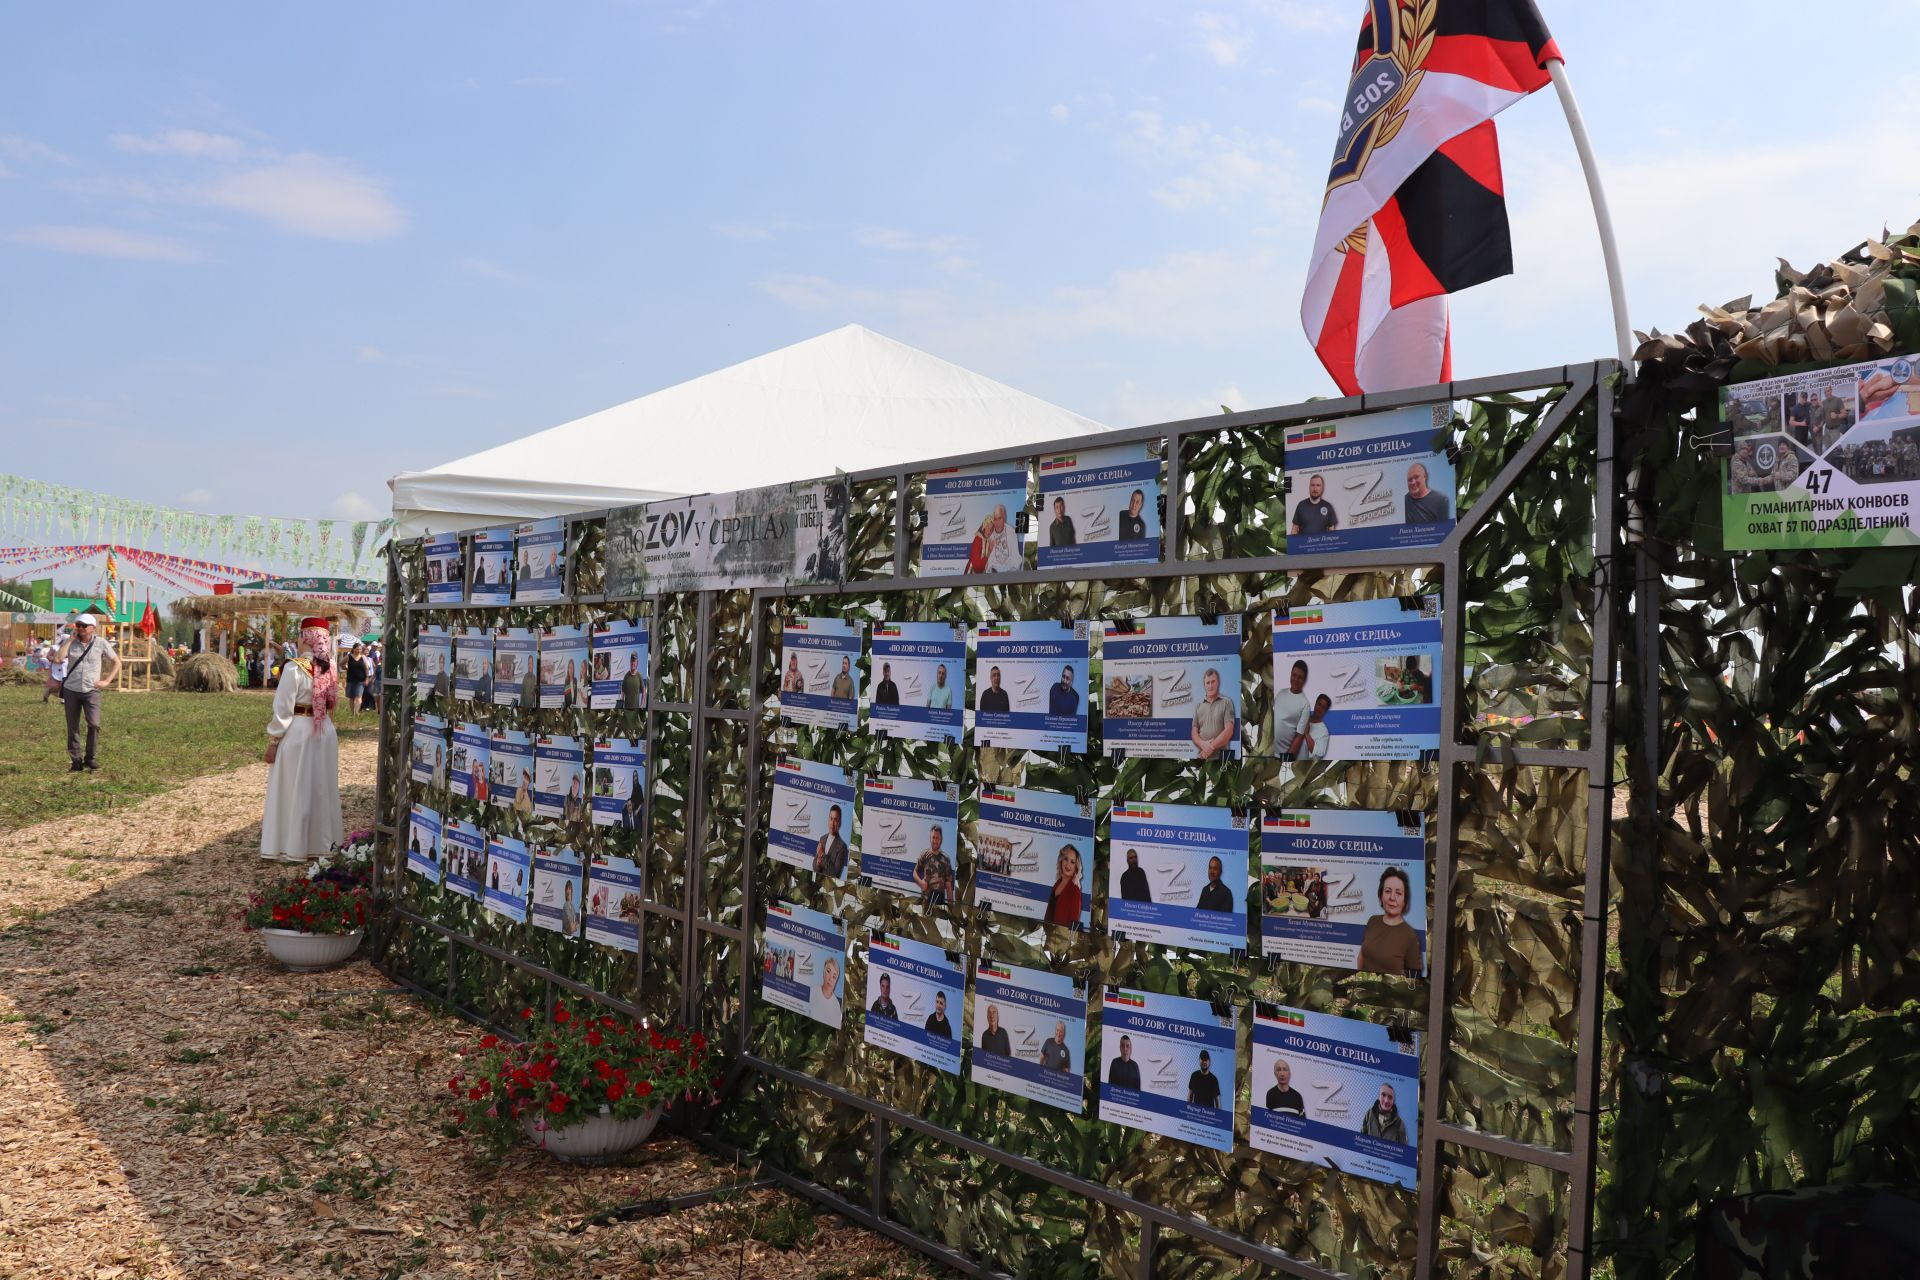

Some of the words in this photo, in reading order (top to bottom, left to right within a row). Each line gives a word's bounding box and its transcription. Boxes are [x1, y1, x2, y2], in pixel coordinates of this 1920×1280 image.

[1833, 363, 1878, 375] общественной
[1317, 450, 1336, 461] «ПО
[1338, 445, 1365, 458] ZОВУ
[1366, 440, 1412, 454] СЕРДЦА»
[1061, 476, 1076, 485] «ПО
[1098, 469, 1132, 482] СЕРДЦА»
[1806, 469, 1833, 495] 47
[1751, 498, 1845, 515] ГУМАНИТАРНЫХ
[1849, 494, 1909, 510] КОНВОЕВ
[709, 513, 790, 546] СЕРДЦА»
[1748, 521, 1783, 534] ОХВАТ
[1786, 521, 1798, 533] 57
[1801, 513, 1910, 534] ПОДРАЗДЕЛЕНИЙ
[1304, 634, 1324, 645] «ПО
[1325, 632, 1352, 644] ZОВУ
[1354, 630, 1402, 642] СЕРДЦА»
[917, 646, 944, 655] СЕРДЦА»
[997, 646, 1010, 654] «ПО
[1012, 646, 1029, 654] ZОВУ
[1031, 646, 1062, 655] СЕРДЦА»
[1129, 645, 1145, 654] «ПО
[1147, 644, 1170, 653] ZОВУ
[1171, 643, 1209, 652] СЕРДЦА»
[881, 798, 892, 806] «ПО
[909, 801, 936, 812] СЕРДЦА»
[1000, 811, 1014, 820] «ПО
[1034, 816, 1066, 828] СЕРДЦА»
[1136, 828, 1153, 837] «ПО
[1154, 829, 1177, 839] ZОВУ
[1178, 831, 1217, 842] СЕРДЦА»
[1292, 839, 1310, 849] «ПО
[1312, 840, 1338, 850] ZОВУ
[1339, 840, 1384, 852] СЕРДЦА»
[887, 956, 899, 966] «ПО
[916, 964, 943, 980] СЕРДЦА»
[997, 987, 1010, 997] «ПО
[1030, 994, 1061, 1009] СЕРДЦА»
[1127, 1016, 1144, 1027] «ПО
[1145, 1019, 1167, 1031] ZОВУ
[1168, 1023, 1206, 1038] СЕРДЦА»
[1284, 1036, 1304, 1048] «ПО
[1306, 1040, 1333, 1054] ZОВУ
[1335, 1046, 1381, 1065] СЕРДЦА»
